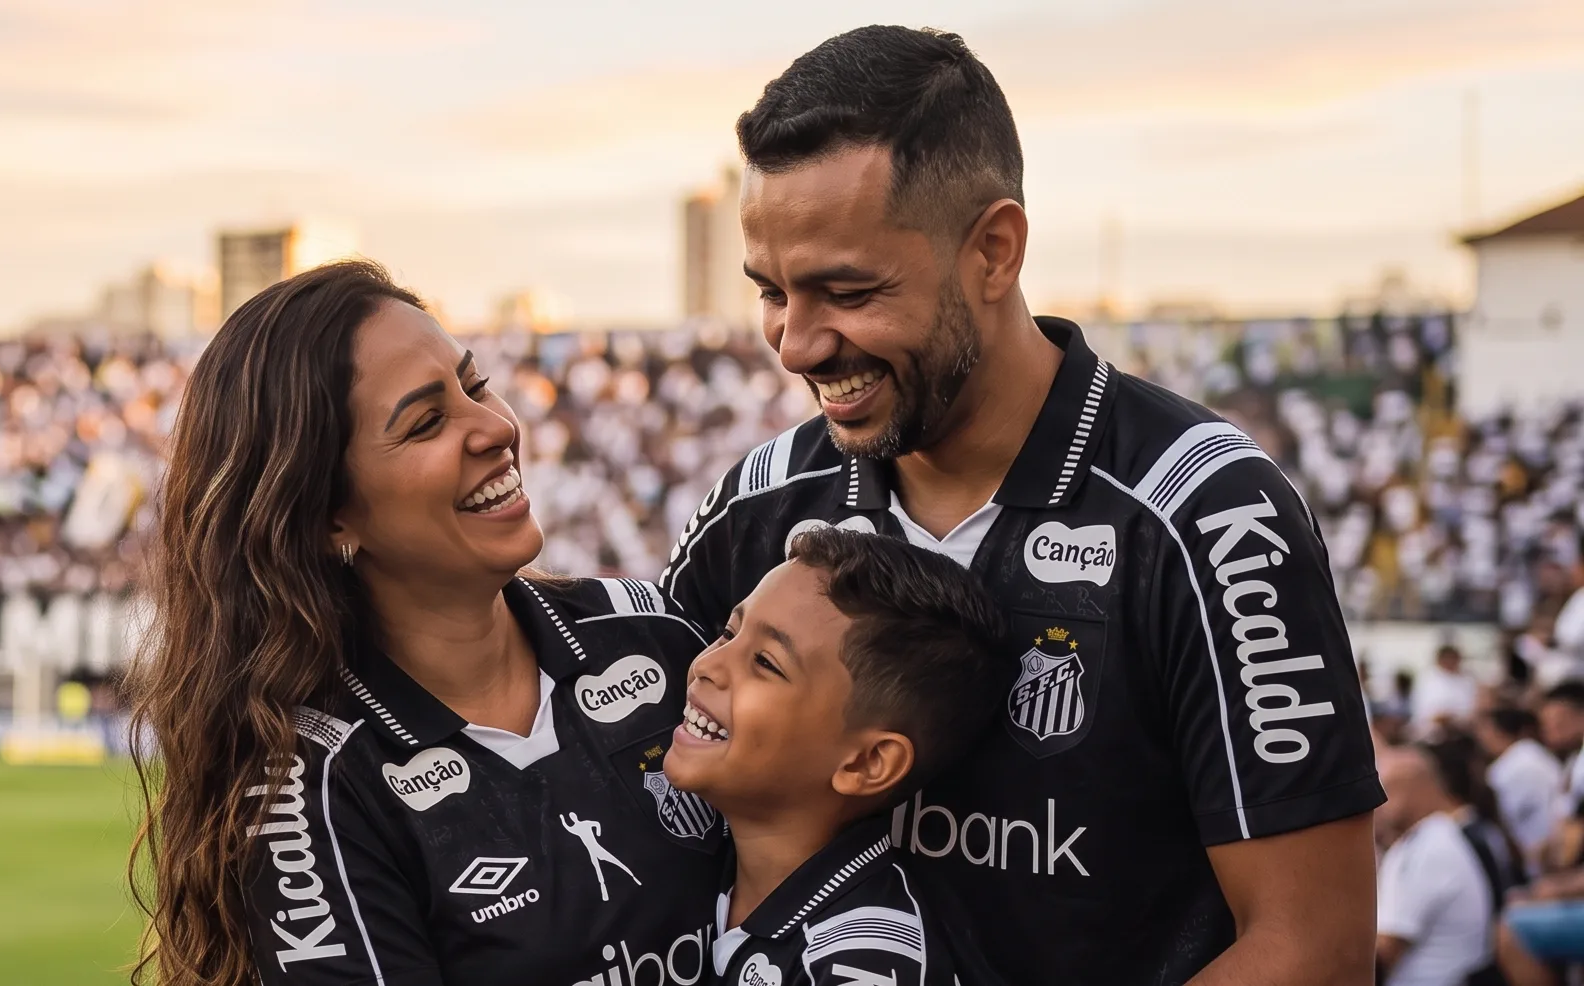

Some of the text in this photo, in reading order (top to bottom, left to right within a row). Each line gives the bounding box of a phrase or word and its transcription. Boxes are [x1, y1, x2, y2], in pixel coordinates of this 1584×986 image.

[1032, 535, 1114, 571] Canção
[1195, 489, 1335, 764] Kicaldo
[581, 666, 661, 711] Canção
[388, 759, 464, 796] Canção
[471, 888, 540, 924] umbro
